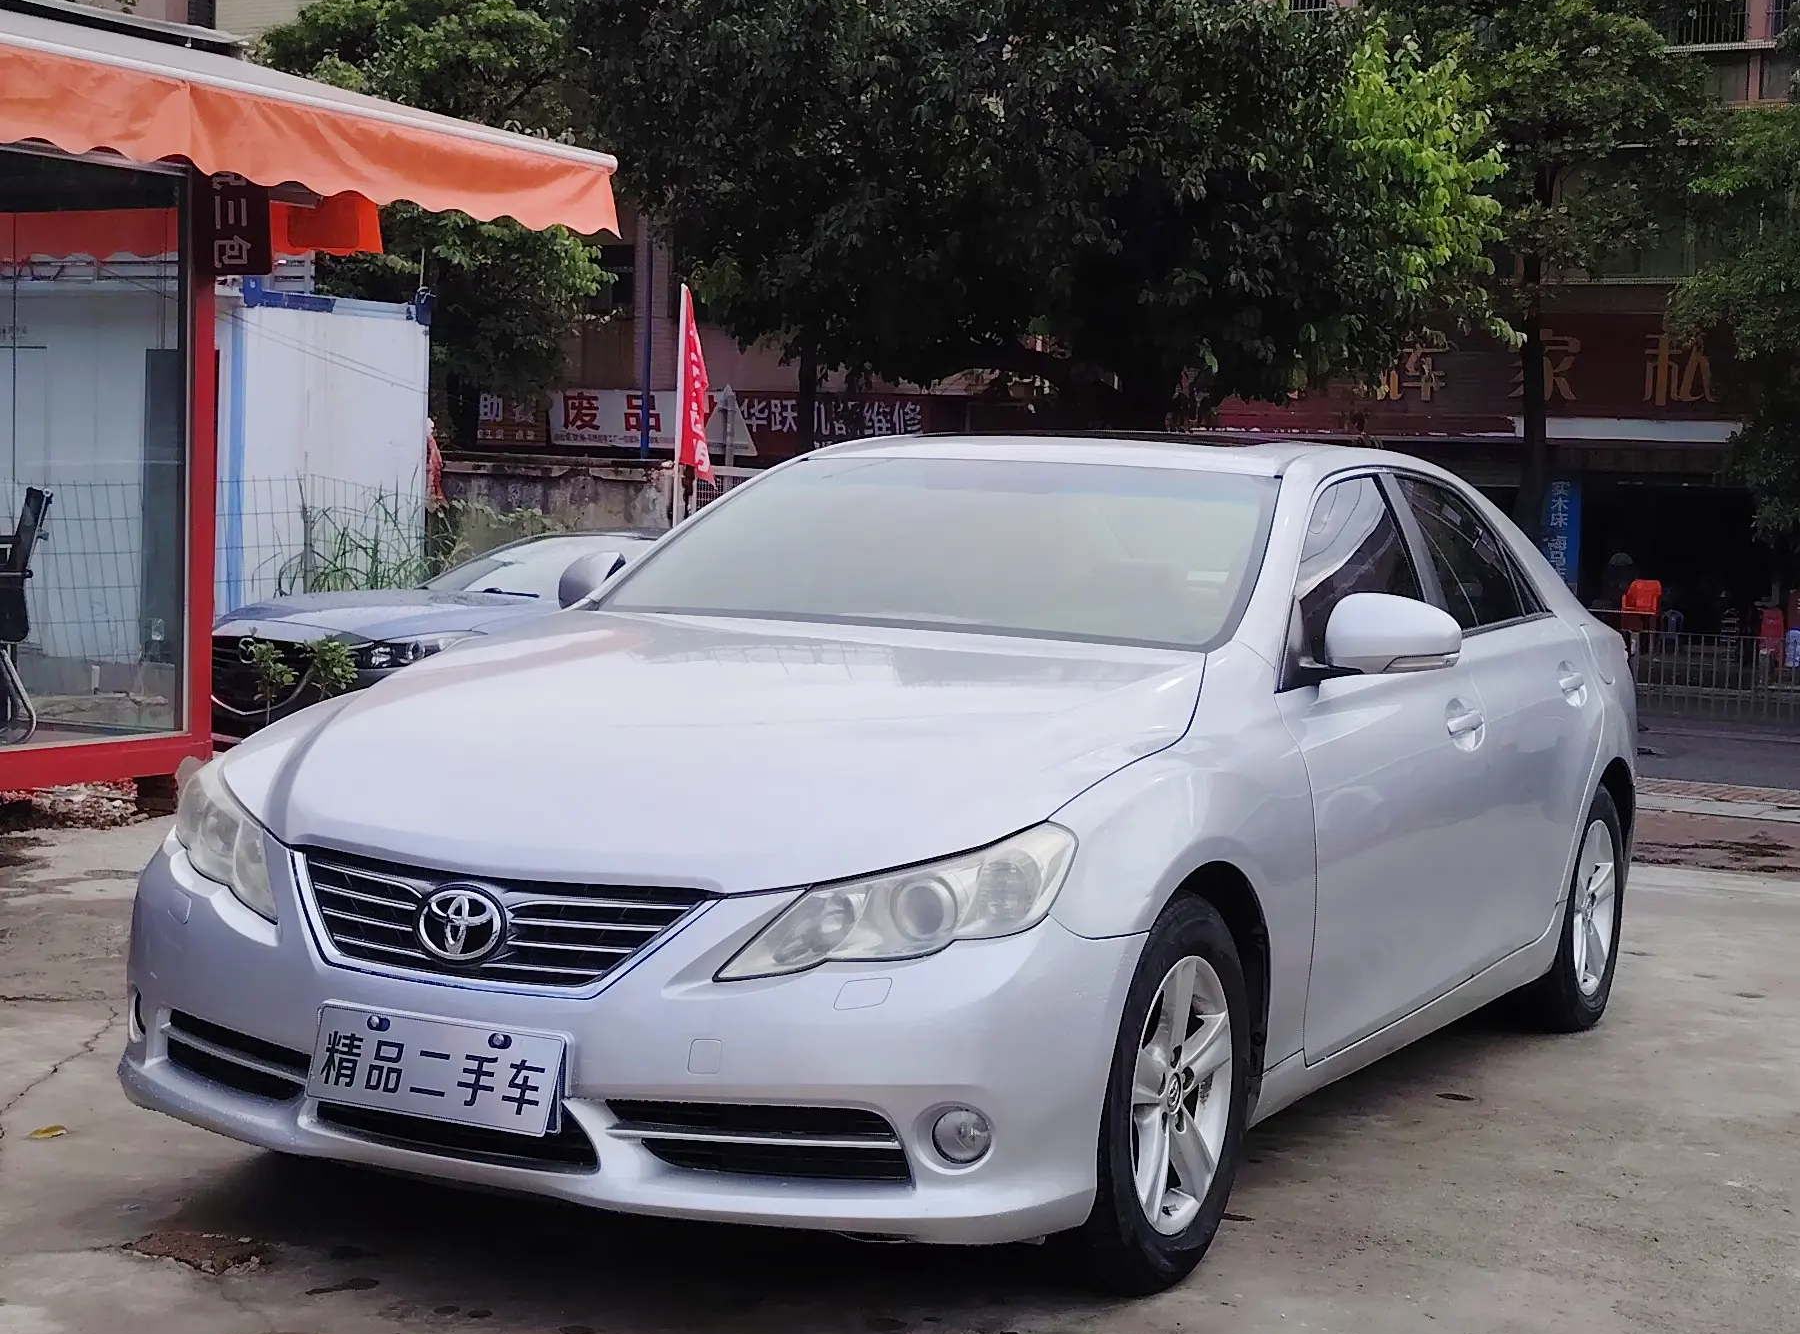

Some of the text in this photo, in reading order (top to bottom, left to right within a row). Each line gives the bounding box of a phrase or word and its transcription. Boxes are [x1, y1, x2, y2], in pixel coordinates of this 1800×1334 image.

[320, 1030, 545, 1116] 精品二手车
